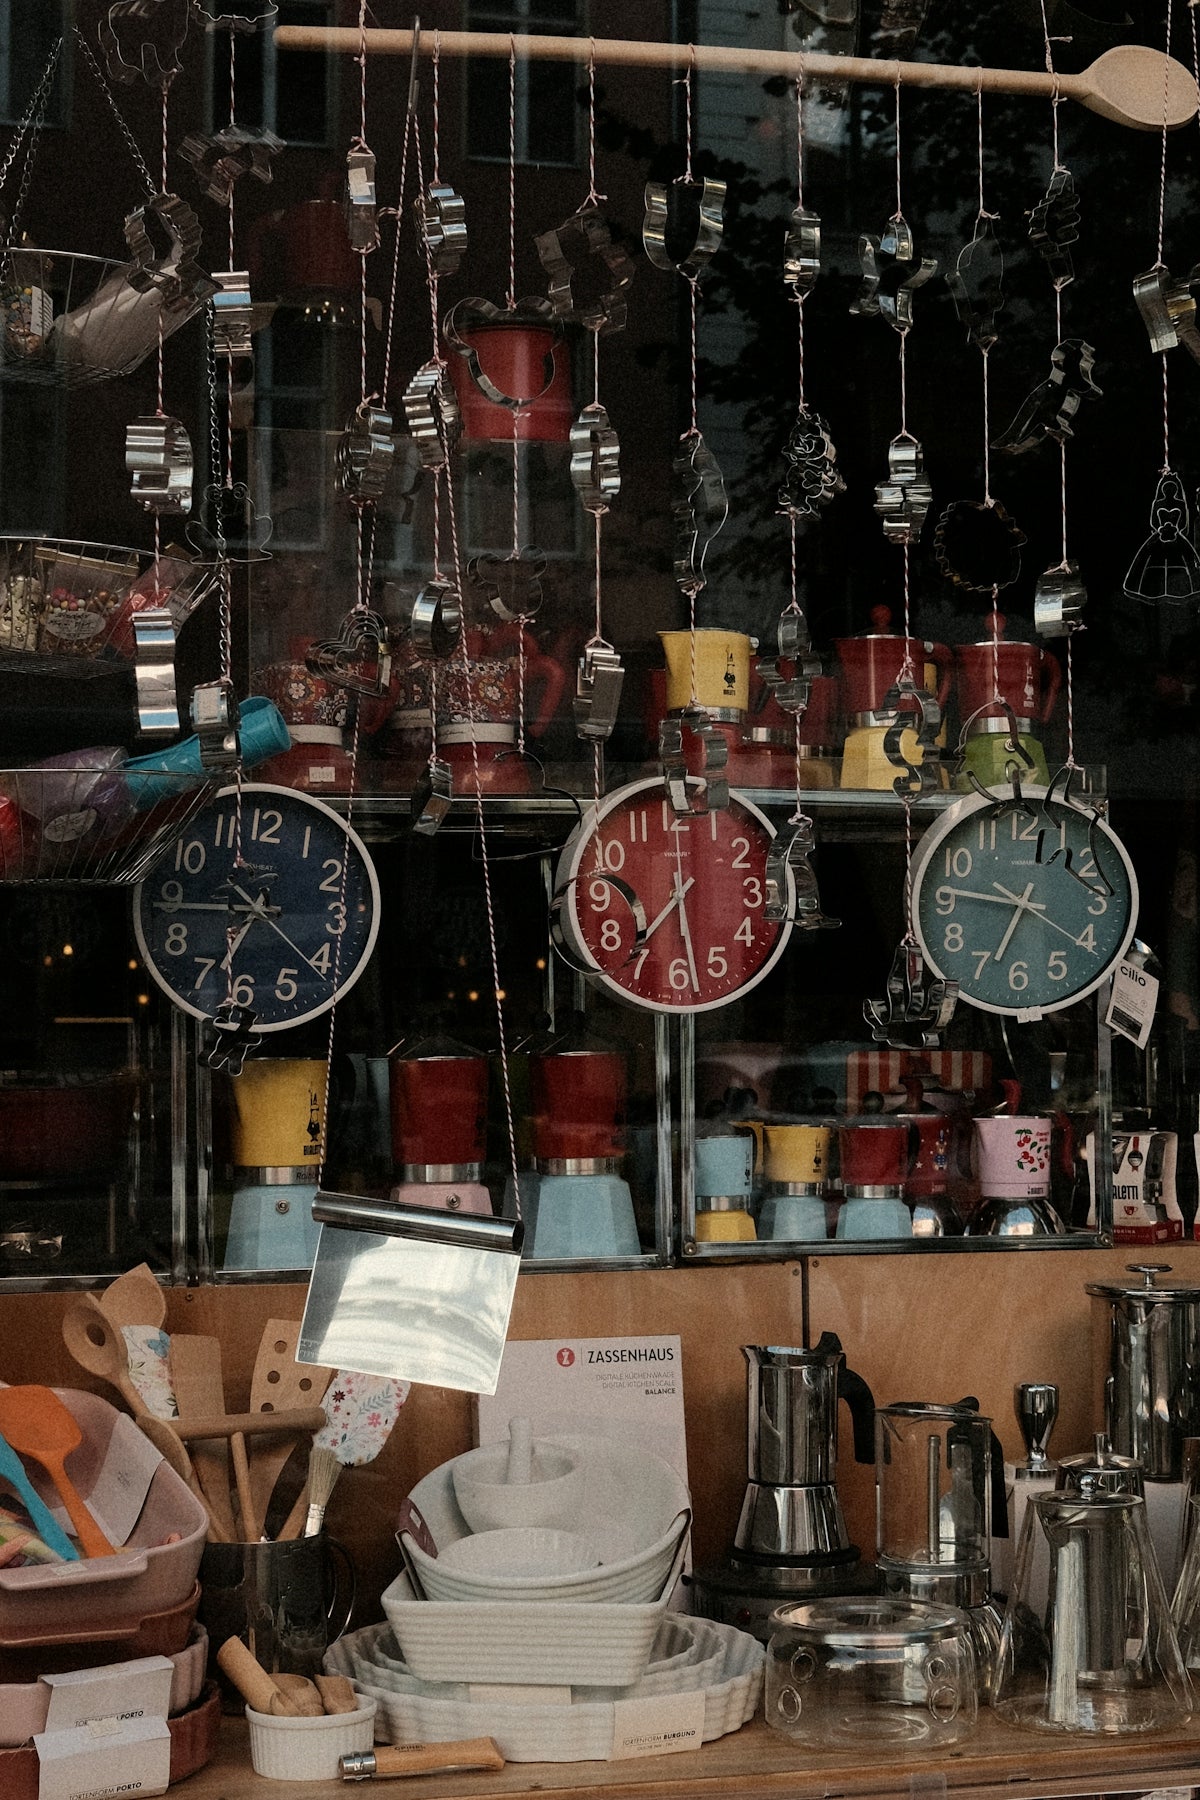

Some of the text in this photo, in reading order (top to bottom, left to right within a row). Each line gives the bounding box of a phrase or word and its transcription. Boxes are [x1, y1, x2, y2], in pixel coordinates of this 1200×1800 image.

[215, 814, 236, 848] 11
[252, 809, 283, 843] 12
[630, 811, 647, 842] 11
[711, 811, 717, 841] 1
[979, 820, 996, 850] 11
[1011, 812, 1039, 841] 12
[1060, 820, 1066, 849] 1
[175, 839, 206, 874] 10
[302, 826, 311, 858] 1
[731, 837, 751, 869] 2
[319, 859, 342, 892] 2
[945, 847, 973, 878] 10
[1078, 848, 1098, 878] 2
[161, 881, 183, 912] 9
[589, 881, 611, 912] 9
[743, 877, 762, 908] 3
[935, 886, 956, 916] 9
[1087, 885, 1108, 915] 3
[325, 902, 347, 935] 3
[734, 916, 755, 947] 4
[165, 923, 188, 956] 8
[600, 919, 621, 951] 8
[943, 923, 964, 952] 8
[1075, 923, 1097, 953] 4
[309, 942, 331, 973] 4
[631, 950, 649, 979] 7
[707, 947, 728, 978] 5
[971, 951, 992, 980] 7
[1047, 951, 1068, 981] 5
[194, 957, 216, 989] 7
[275, 968, 298, 1001] 5
[668, 958, 690, 990] 6
[1008, 961, 1029, 991] 6
[1120, 965, 1147, 987] cilio
[232, 974, 255, 1008] 6
[1112, 1185, 1139, 1200] ALETTI
[588, 1347, 674, 1364] ZASSENHAUS
[596, 1373, 623, 1381] DIGITALE
[627, 1381, 655, 1389] KITCHEN
[645, 1387, 676, 1396] BALANCE
[120, 1710, 144, 1721] PORTO
[663, 1730, 696, 1740] BURGUND
[69, 1787, 115, 1800] TORTENFORM
[116, 1782, 142, 1793] PORTO
